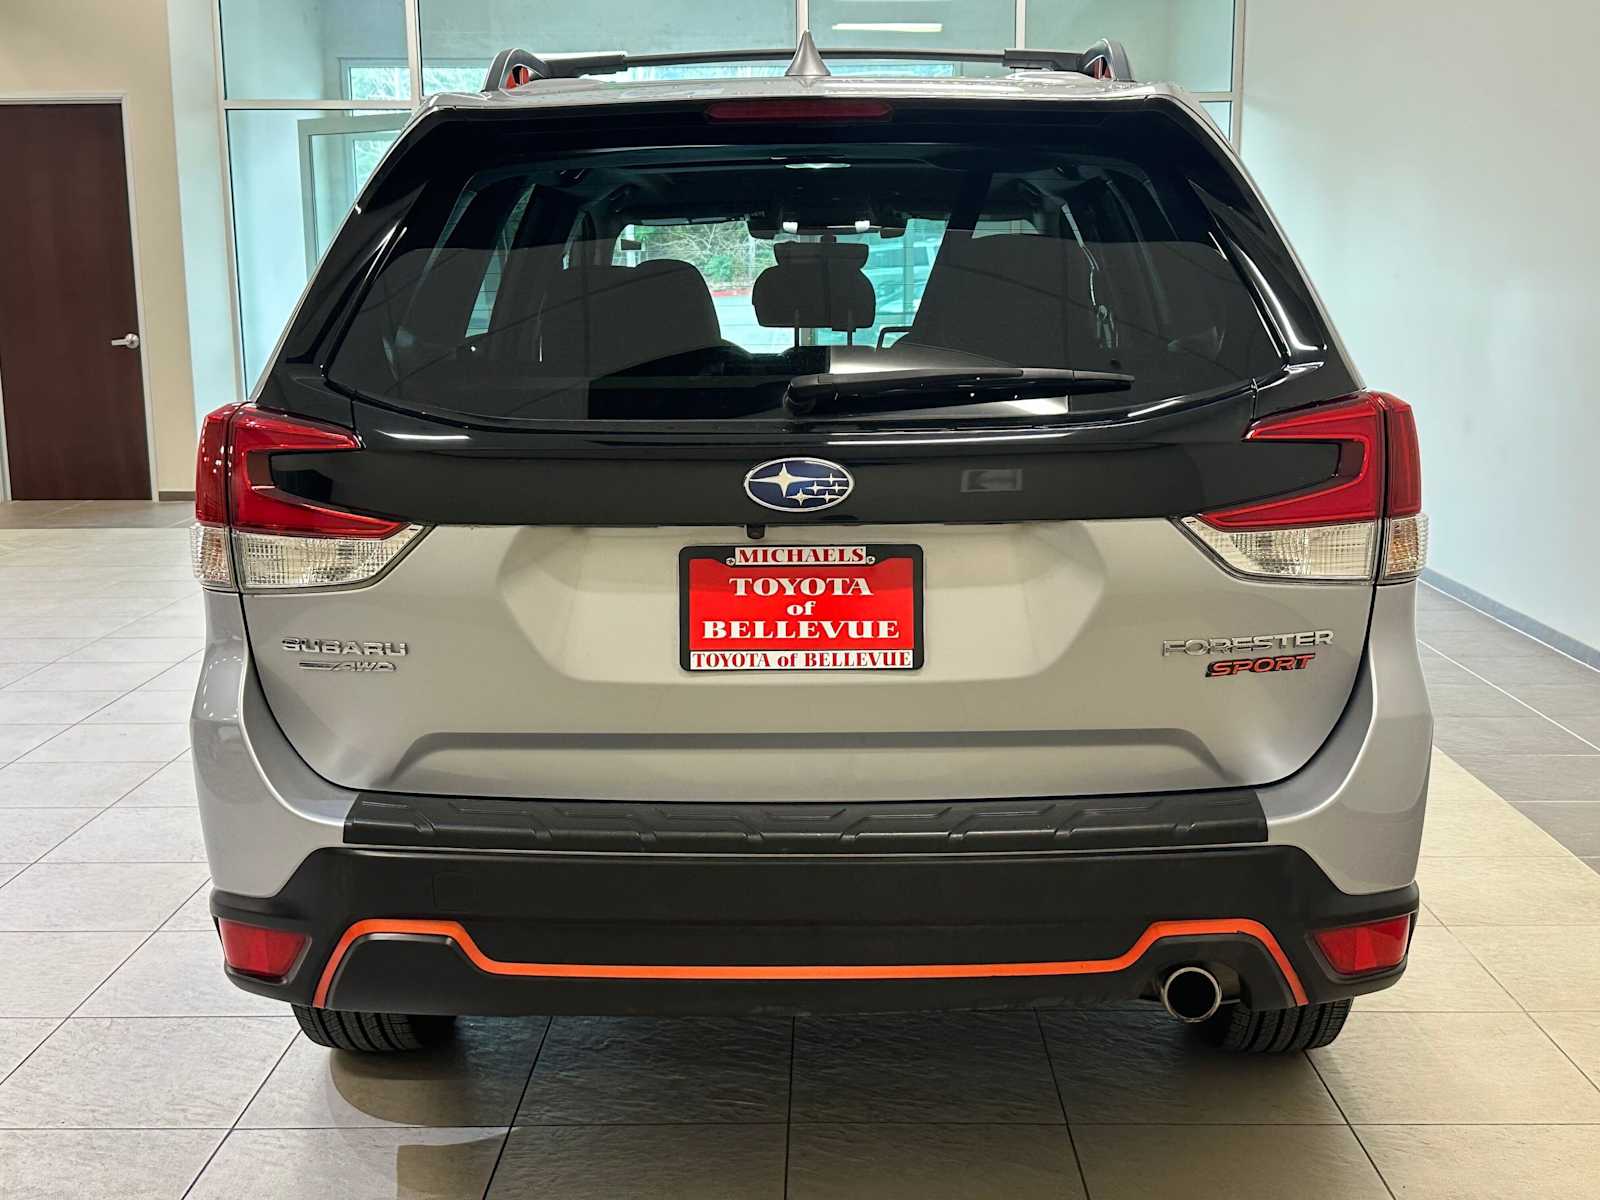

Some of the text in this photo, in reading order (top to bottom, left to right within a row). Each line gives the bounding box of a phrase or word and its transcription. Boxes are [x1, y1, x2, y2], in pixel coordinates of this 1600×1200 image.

[738, 548, 865, 564] MICHAELS
[729, 577, 874, 596] TOYOTA
[786, 601, 816, 616] of
[703, 620, 900, 639] BELLEVUE
[281, 637, 408, 656] SUBARU
[1162, 629, 1335, 657] FORESTER
[330, 661, 397, 672] AWD
[692, 651, 912, 668] TOYOTA of BELLEVUE
[1205, 653, 1316, 677] SPORT
